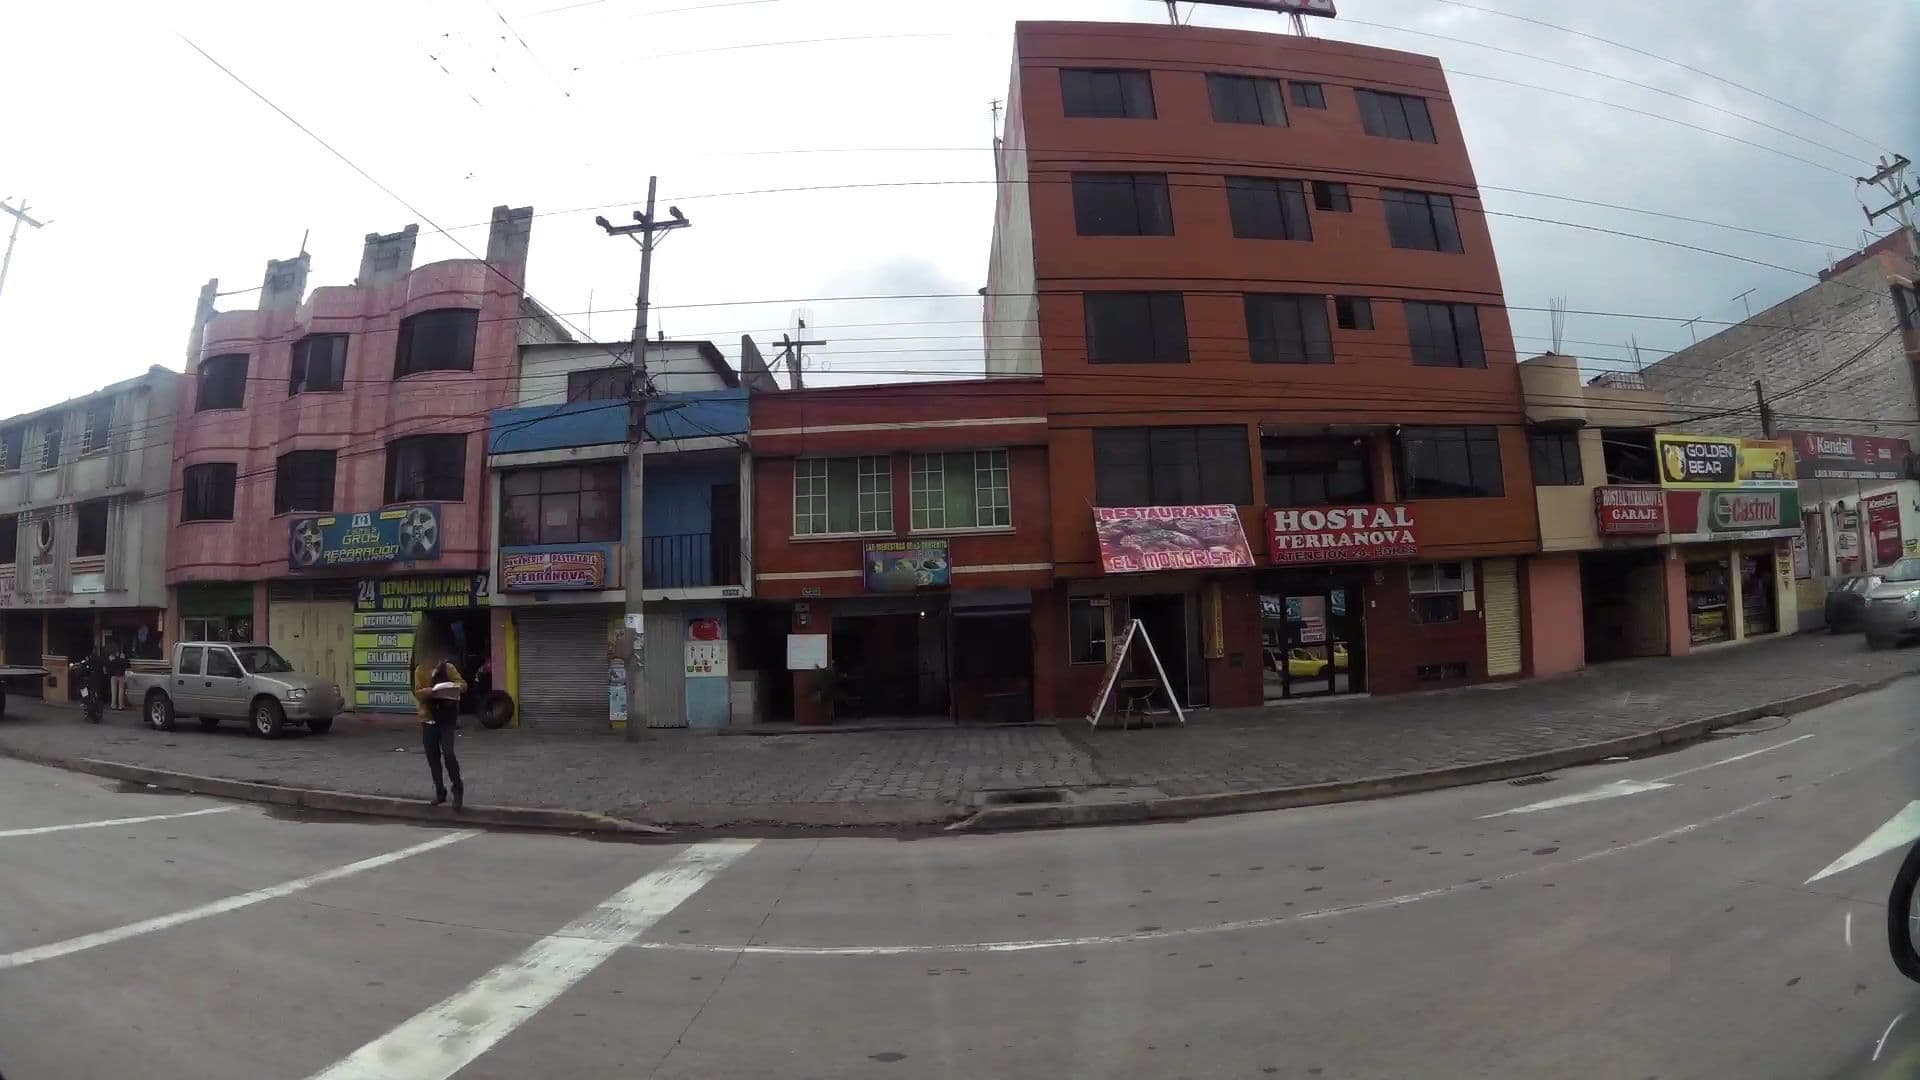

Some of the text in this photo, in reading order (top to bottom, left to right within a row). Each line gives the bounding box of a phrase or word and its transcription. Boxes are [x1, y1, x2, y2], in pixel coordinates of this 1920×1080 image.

[1686, 444, 1733, 458] GOLDEN
[1816, 437, 1853, 454] Kendall
[1687, 460, 1723, 474] BEAR
[1100, 505, 1232, 521] RESTAURANTE
[1612, 509, 1658, 520] GARAJE
[1732, 497, 1777, 522] Castrol
[1273, 506, 1415, 532] HOSTAL
[1275, 529, 1416, 550] TERRANOVA
[1111, 549, 1247, 570] EL MOTORISTA
[358, 579, 376, 599] 24
